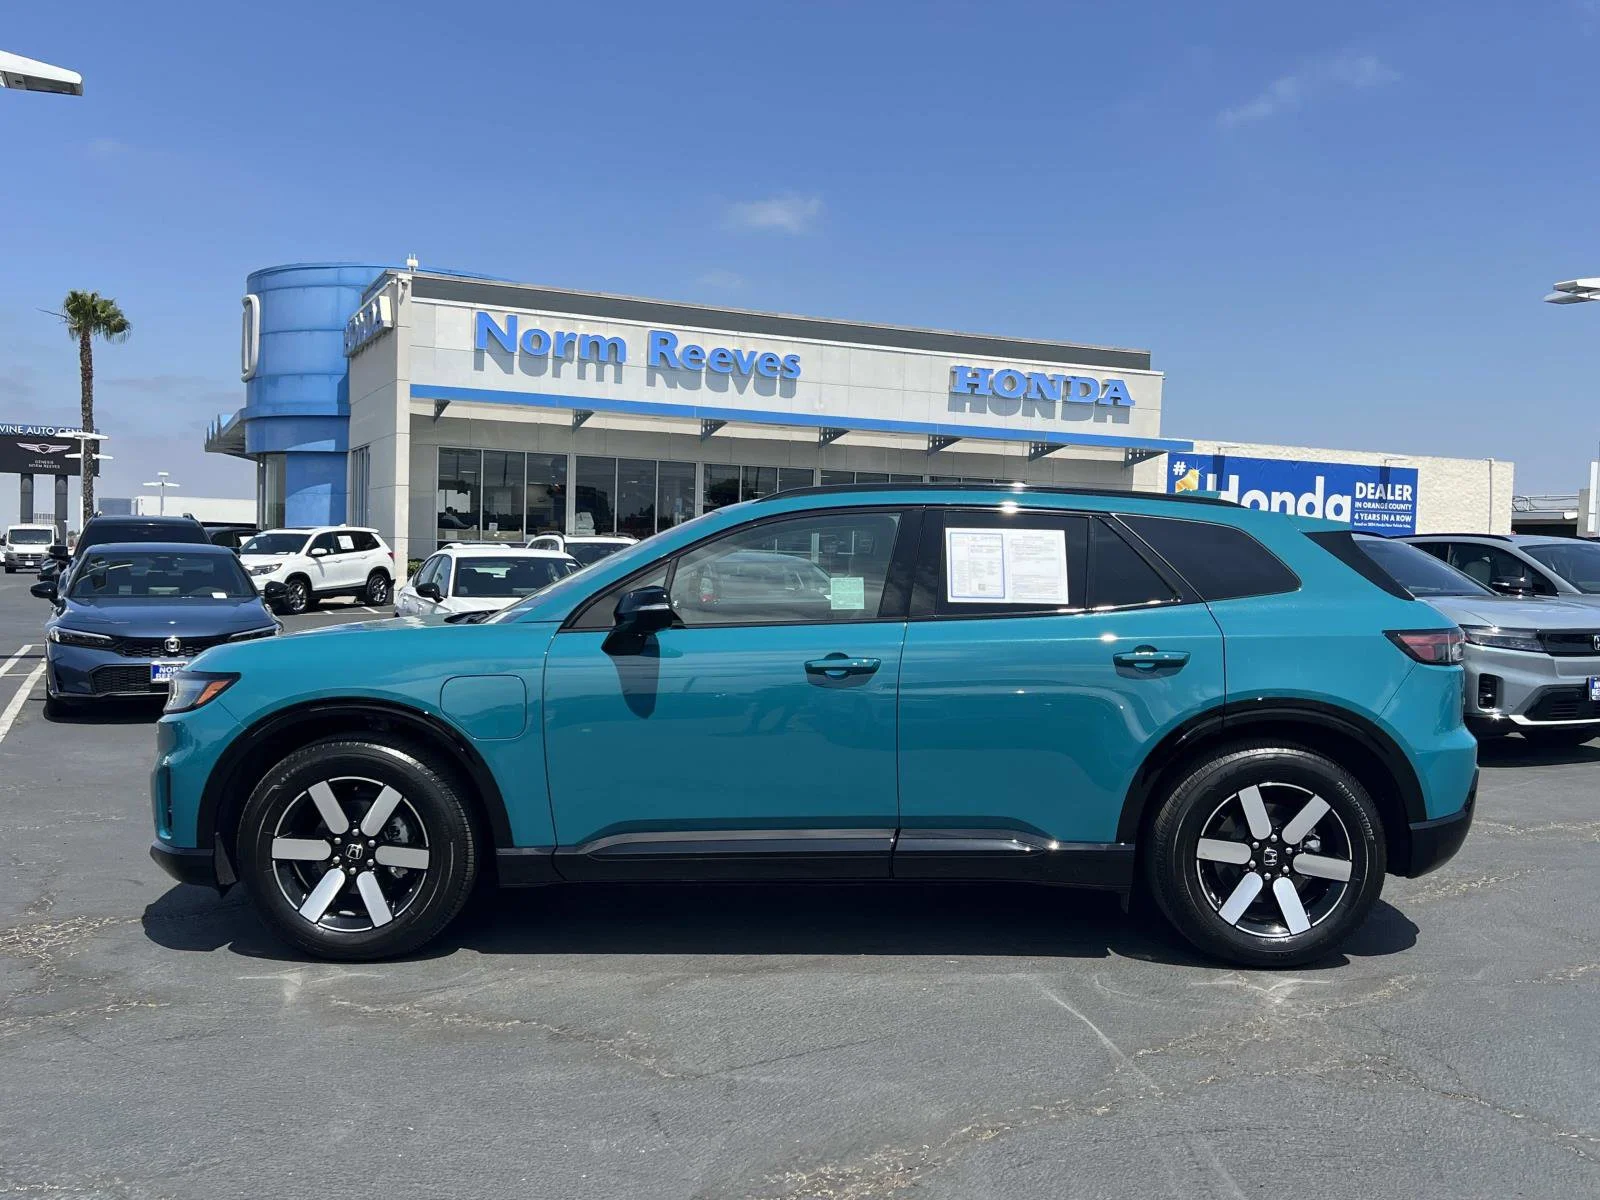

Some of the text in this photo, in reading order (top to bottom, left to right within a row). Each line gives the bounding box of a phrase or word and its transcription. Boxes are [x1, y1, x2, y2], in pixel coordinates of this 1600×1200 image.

[475, 311, 801, 379] Norm Reeves
[951, 365, 1136, 406] HONDA
[26, 426, 55, 435] AUTO
[1356, 482, 1412, 501] DEALER
[1362, 502, 1388, 510] ORANGE
[1388, 503, 1412, 511] COUNTY
